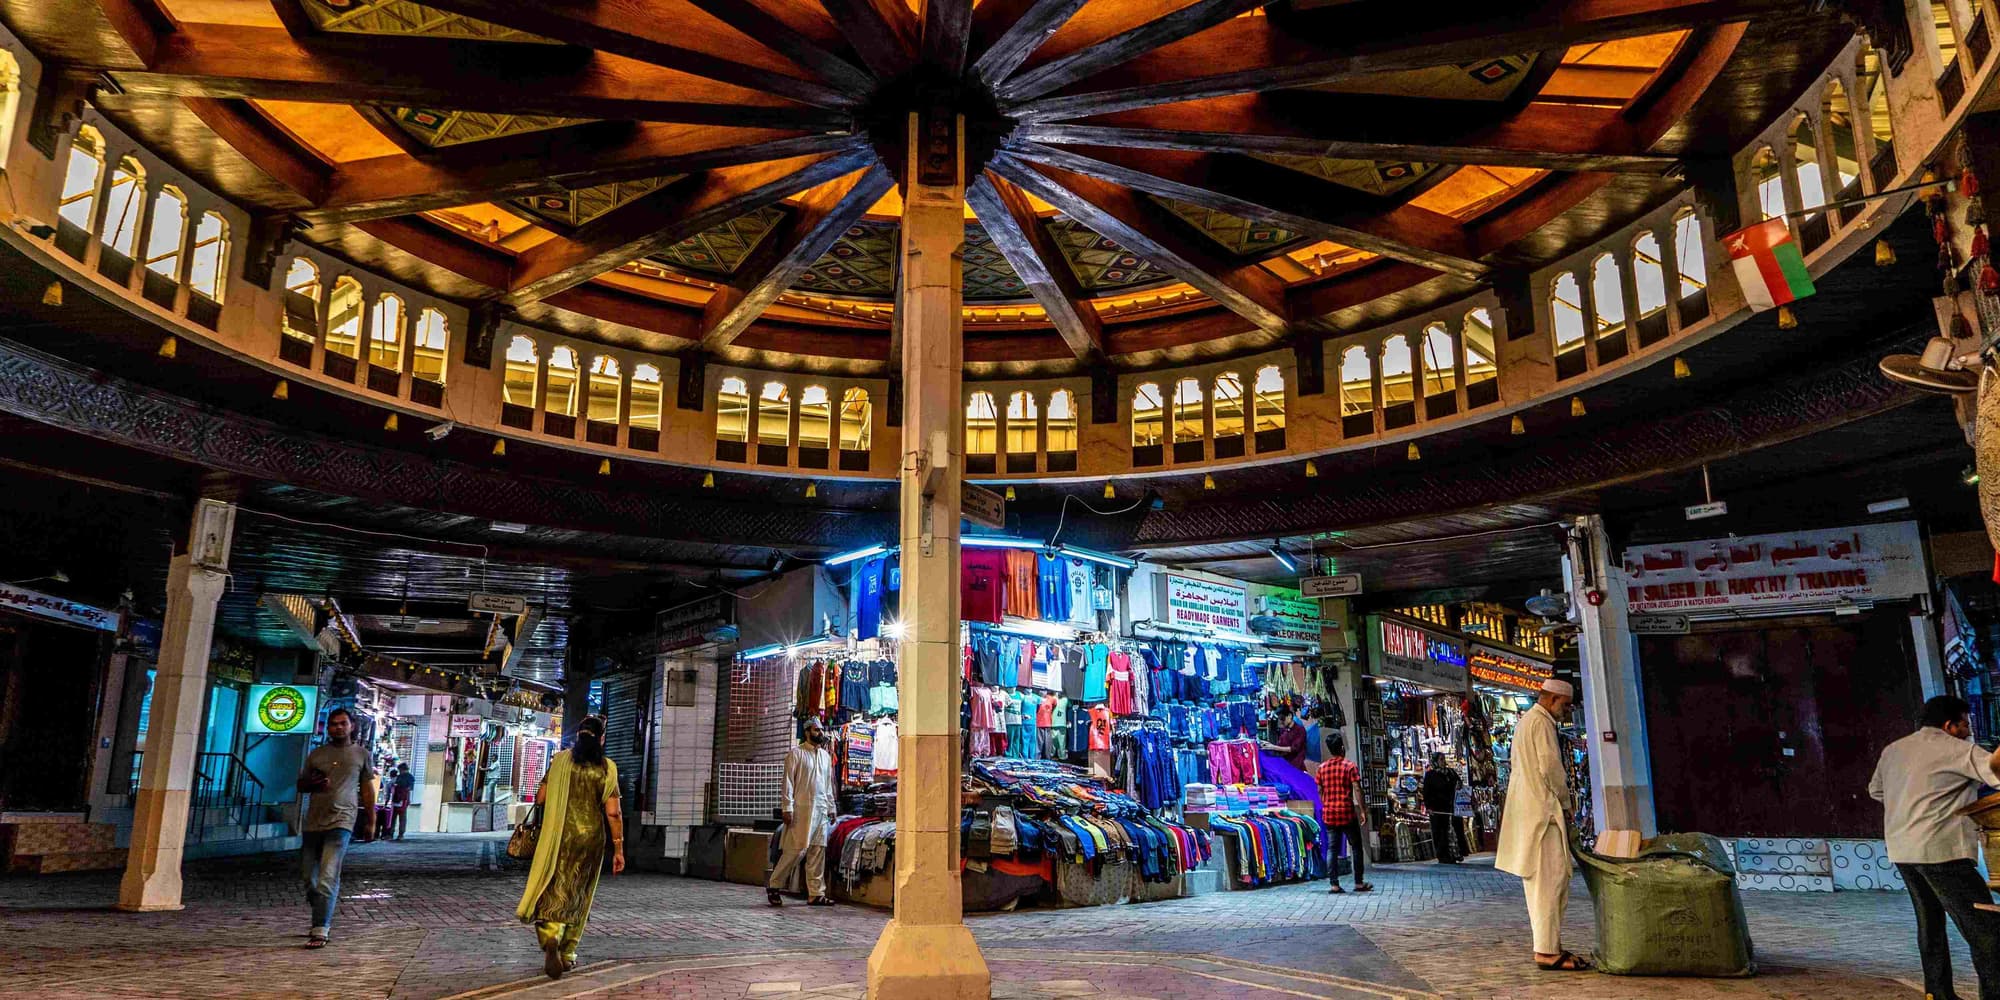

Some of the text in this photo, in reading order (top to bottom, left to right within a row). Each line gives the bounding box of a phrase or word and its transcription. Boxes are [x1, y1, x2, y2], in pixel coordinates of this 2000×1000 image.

[1175, 588, 1208, 602] الجاهزة
[1176, 609, 1210, 624] READYMADE
[1212, 614, 1240, 628] GARMENTS
[1272, 609, 1302, 619] البخو
